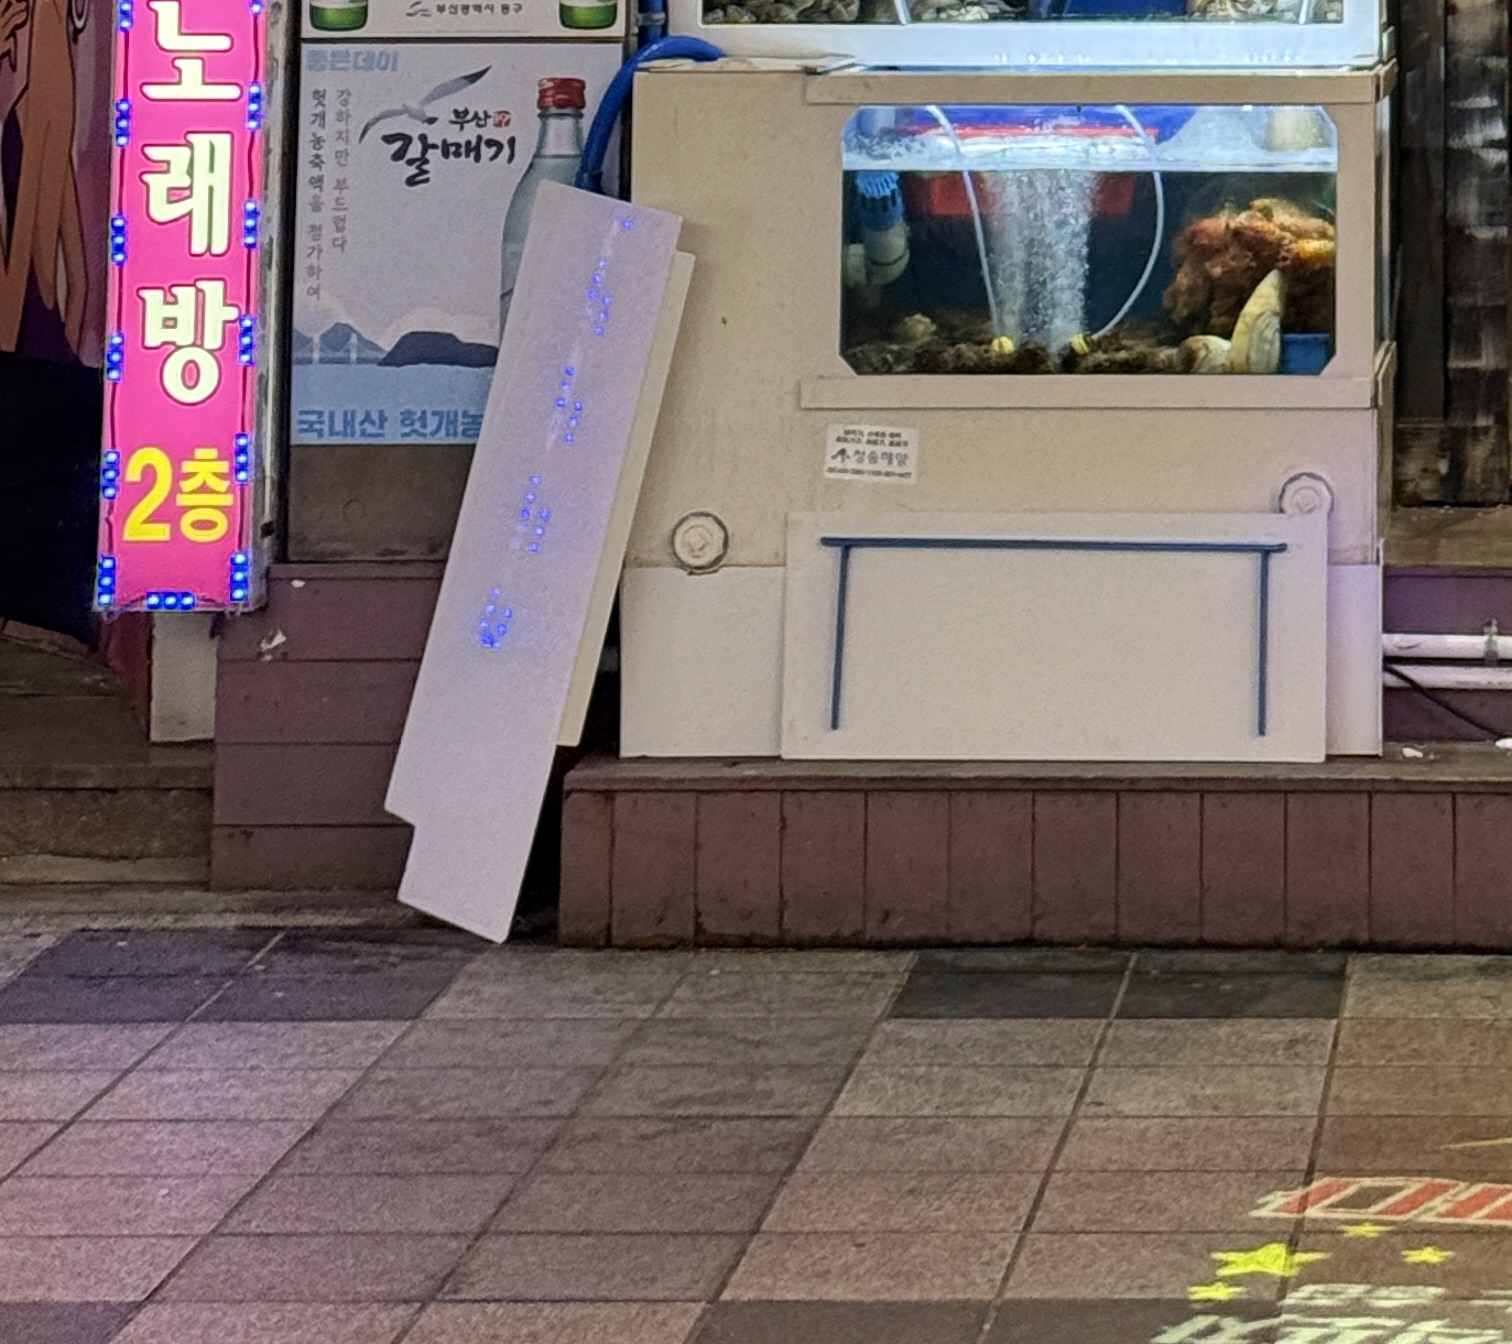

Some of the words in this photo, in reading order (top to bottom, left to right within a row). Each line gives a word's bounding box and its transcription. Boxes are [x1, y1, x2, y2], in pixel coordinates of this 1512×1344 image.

[306, 50, 399, 72] 좋은데이
[449, 107, 492, 132] 부산
[381, 132, 516, 187] 갈매기
[296, 408, 387, 440] 국내산
[122, 445, 235, 545] 2층
